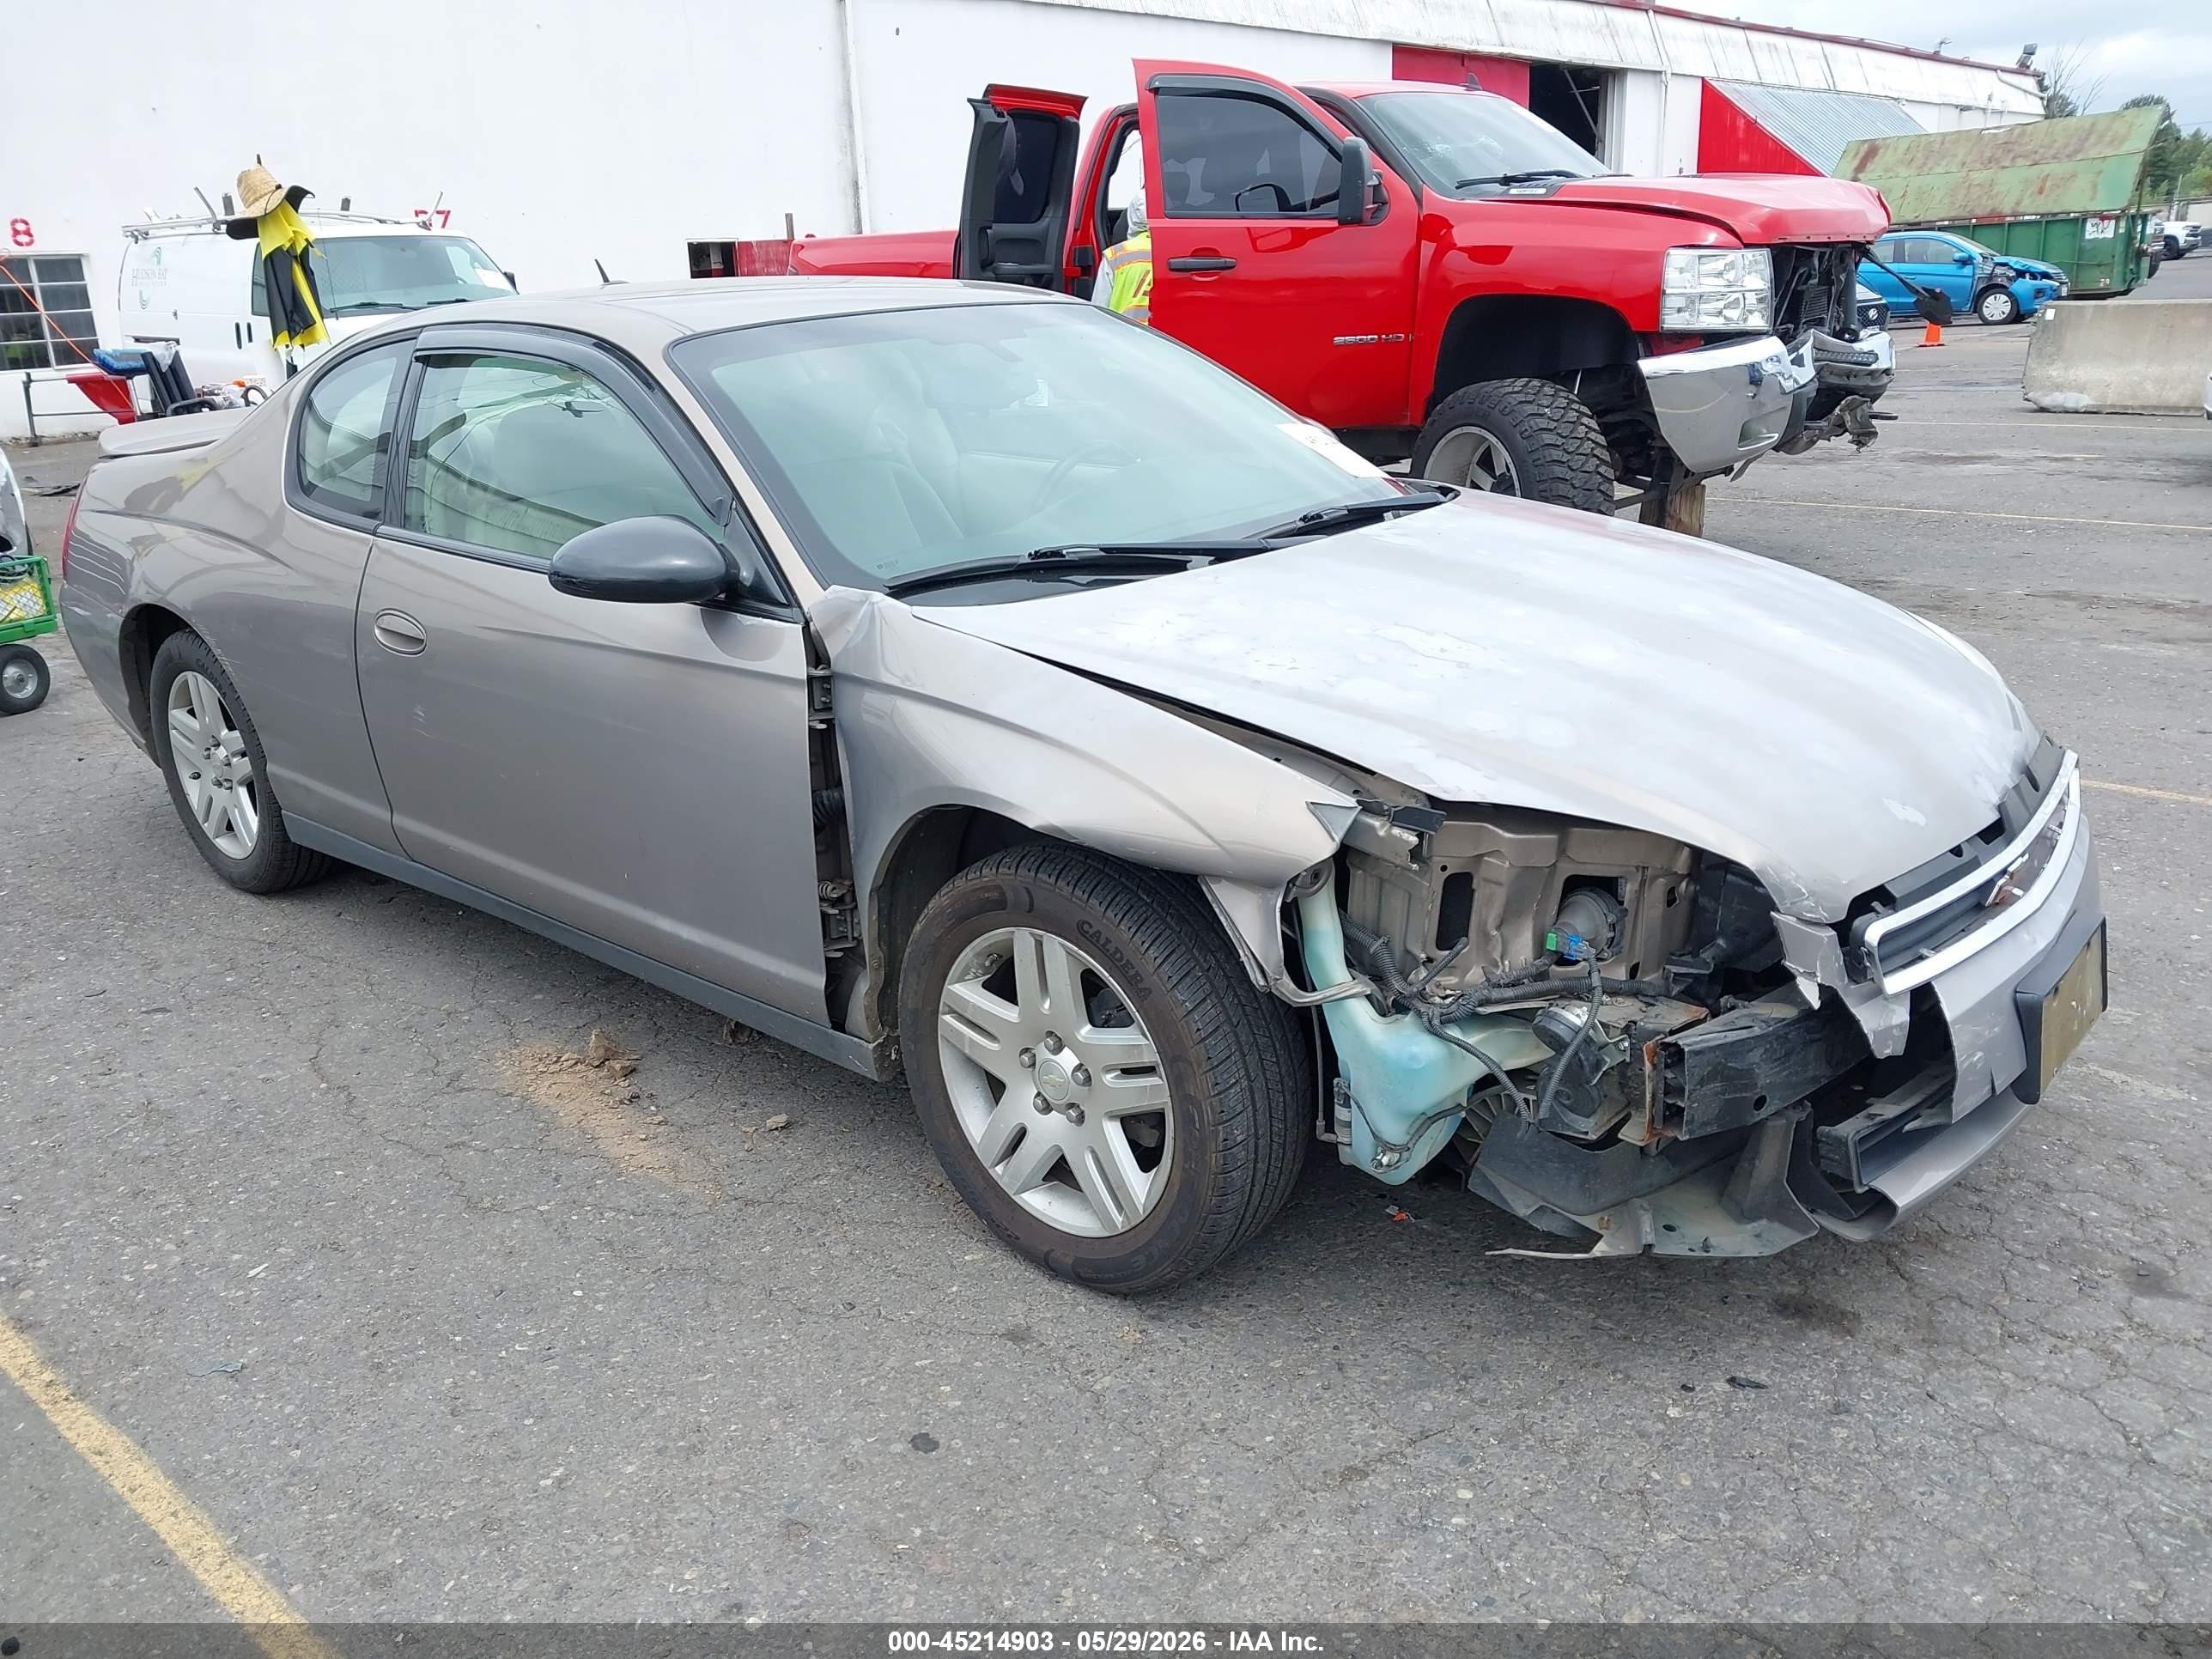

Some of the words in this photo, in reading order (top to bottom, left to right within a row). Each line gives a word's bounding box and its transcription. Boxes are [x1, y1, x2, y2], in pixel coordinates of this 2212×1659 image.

[10, 218, 34, 247] 8
[1333, 335, 1378, 344] 2500
[1381, 333, 1405, 343] HD
[1079, 920, 1153, 1002] CALDERA
